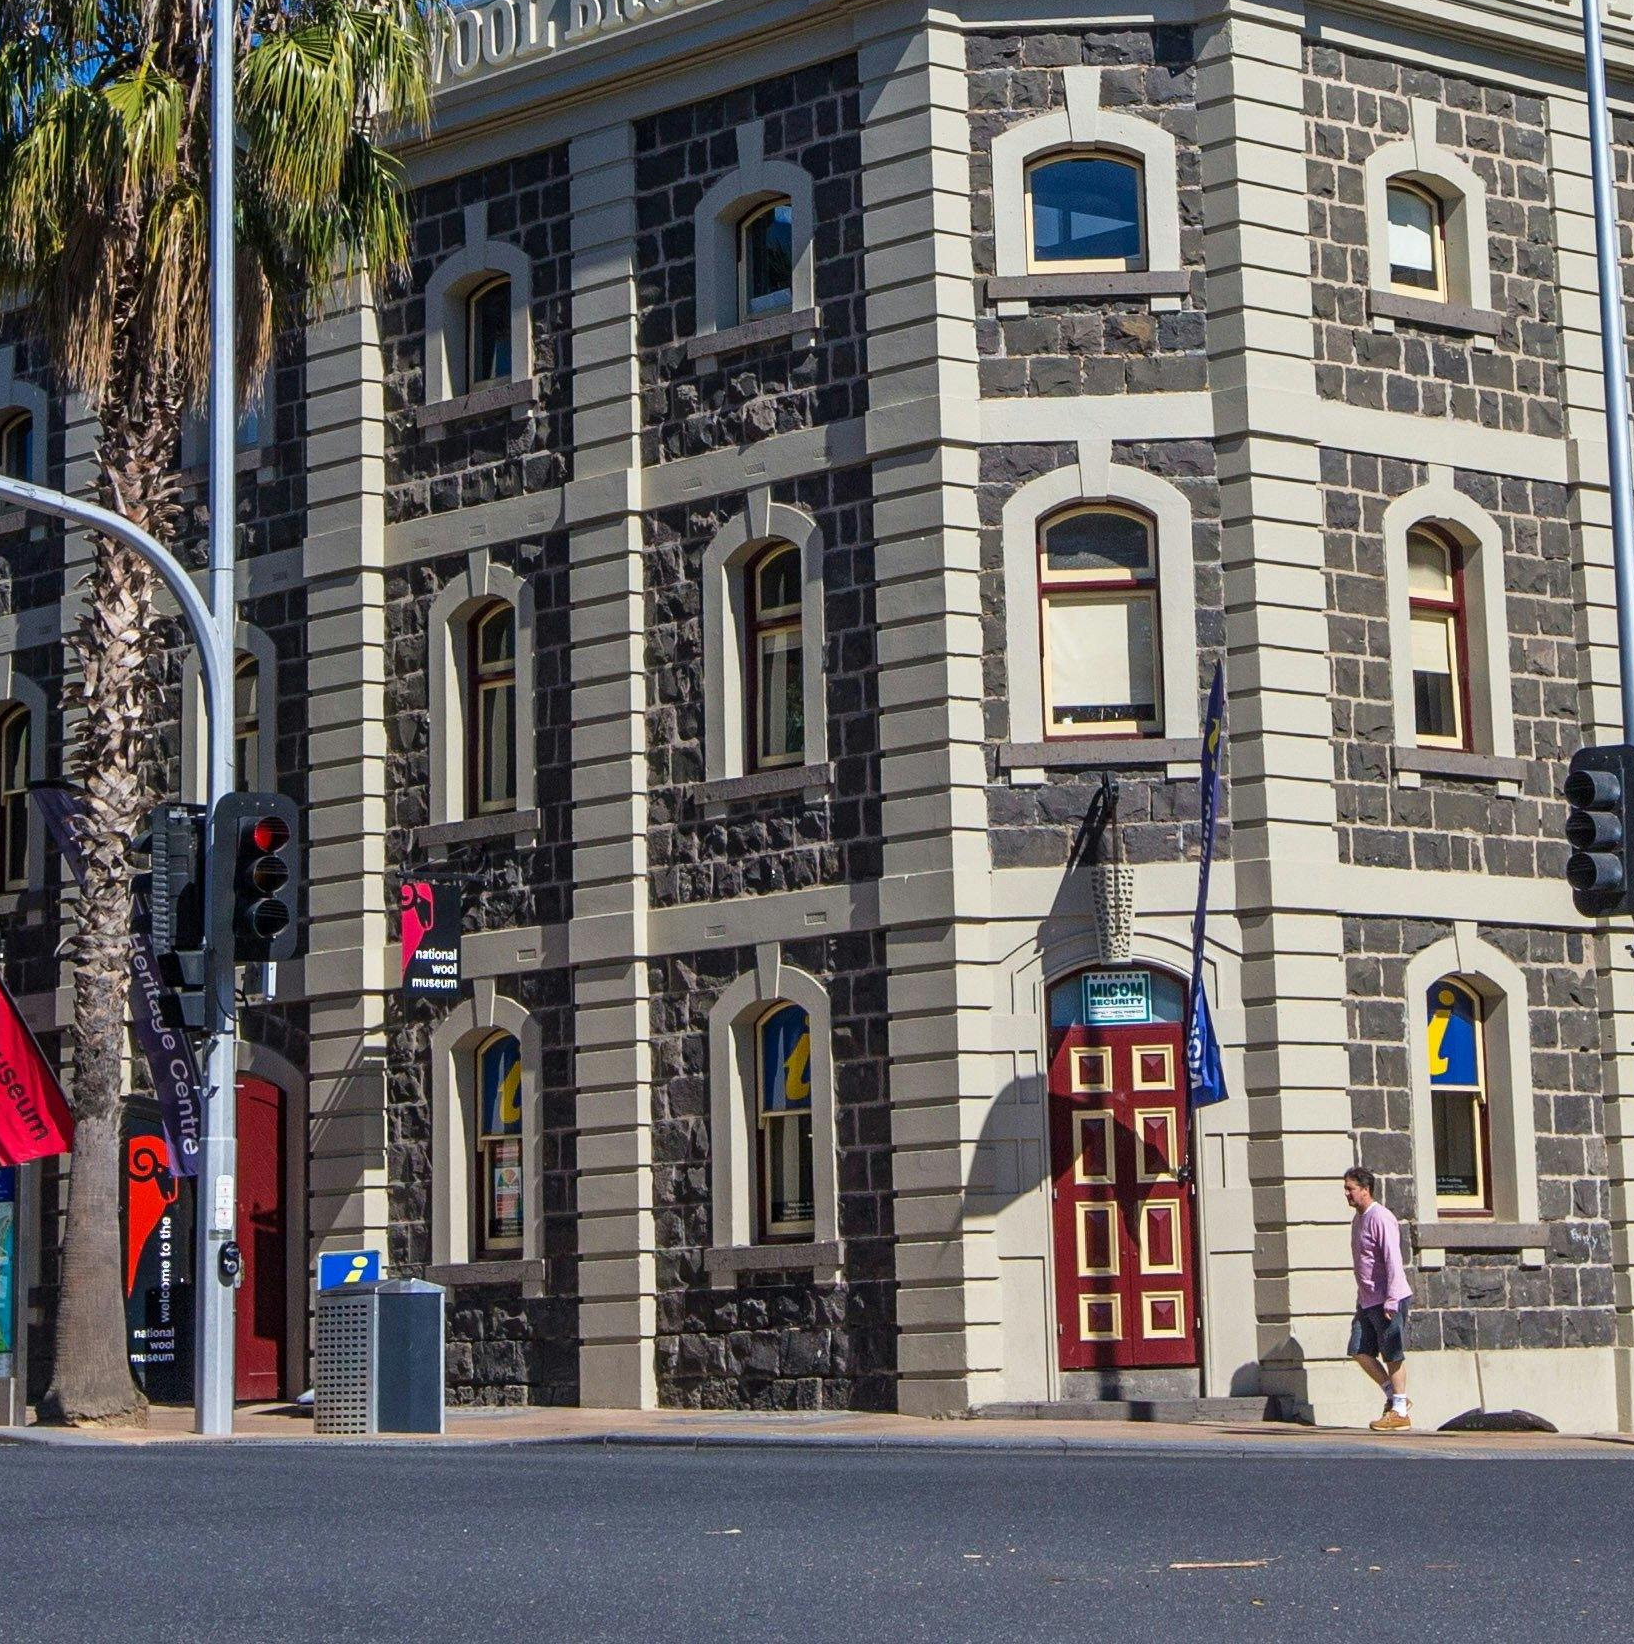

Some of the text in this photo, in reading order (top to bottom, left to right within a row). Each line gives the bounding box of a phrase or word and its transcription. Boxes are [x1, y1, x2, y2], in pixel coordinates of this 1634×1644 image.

[415, 948, 457, 961] national
[431, 962, 457, 975] wool
[1092, 973, 1140, 981] WARNING
[412, 978, 458, 990] museum
[1089, 982, 1143, 998] MICOM
[1090, 997, 1143, 1006] SECURITY
[124, 931, 200, 1156] Heritage Centre
[159, 1216, 171, 1323] welcome to the
[133, 1327, 175, 1339] national
[150, 1338, 175, 1350] wool
[131, 1351, 175, 1363] museum
